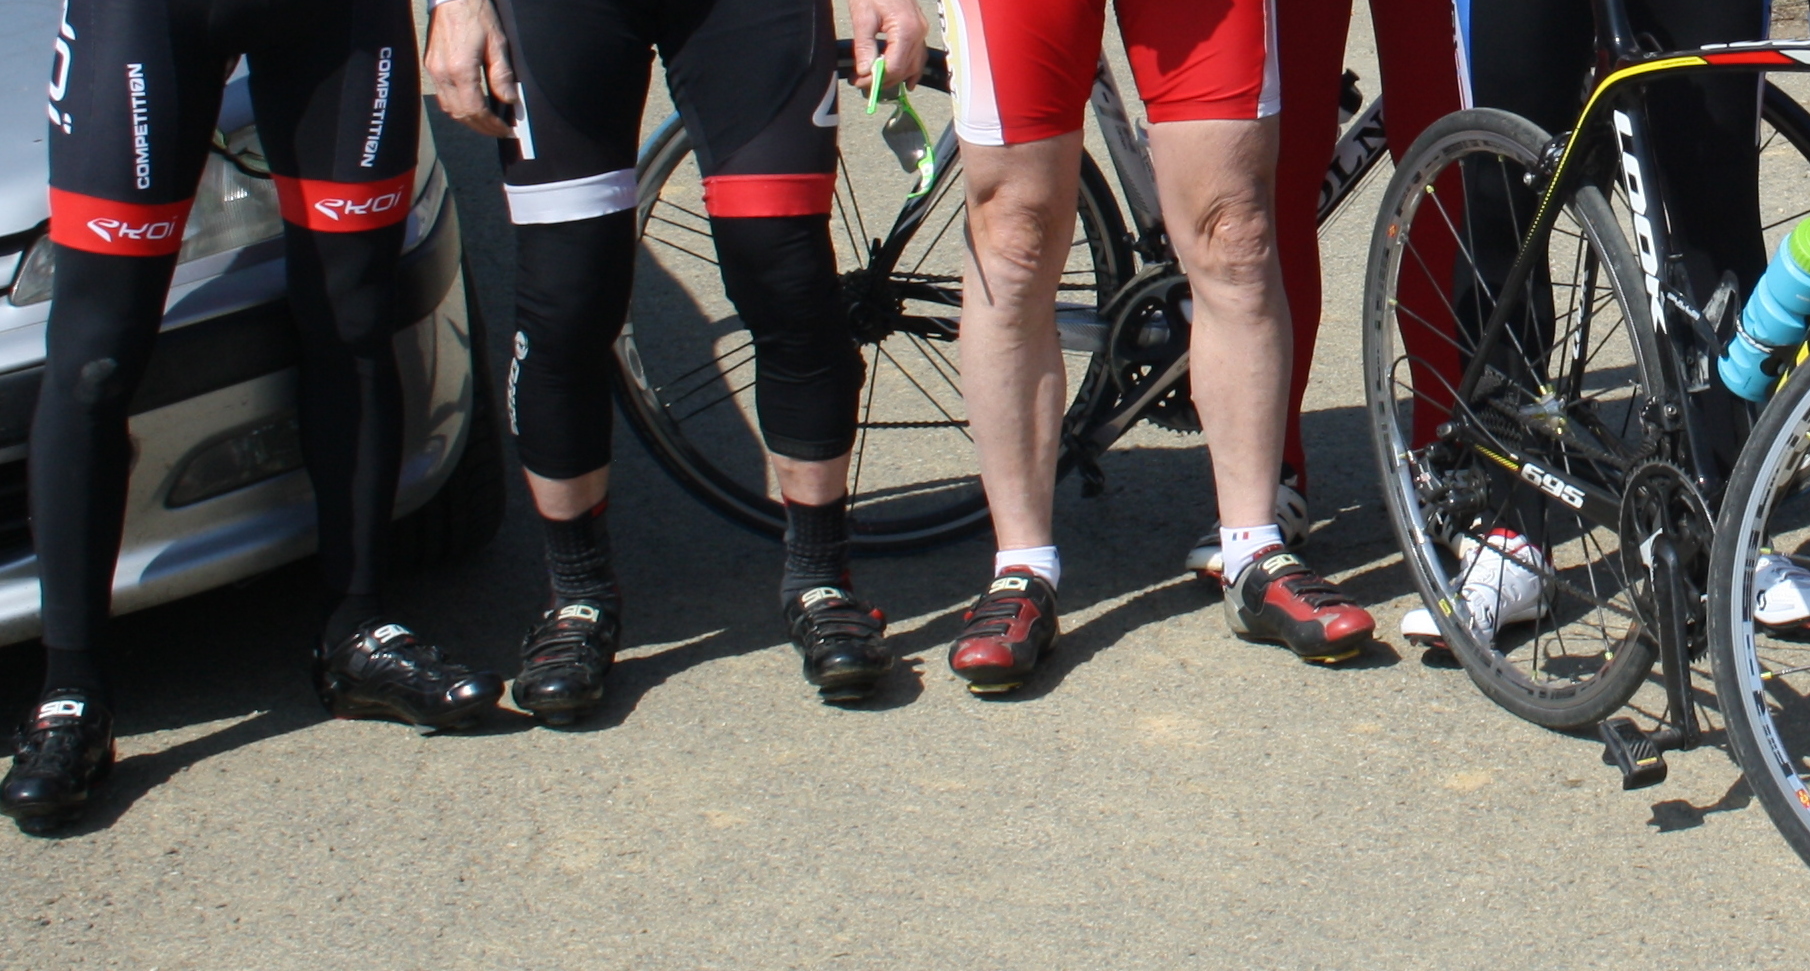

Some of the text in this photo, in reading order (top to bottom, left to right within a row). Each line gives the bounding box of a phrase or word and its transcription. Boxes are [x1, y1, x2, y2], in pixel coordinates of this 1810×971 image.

[127, 63, 151, 190] COMPETITION
[360, 46, 393, 169] COMPETITION
[1613, 108, 1669, 335] LOOK
[1520, 462, 1586, 510] 695
